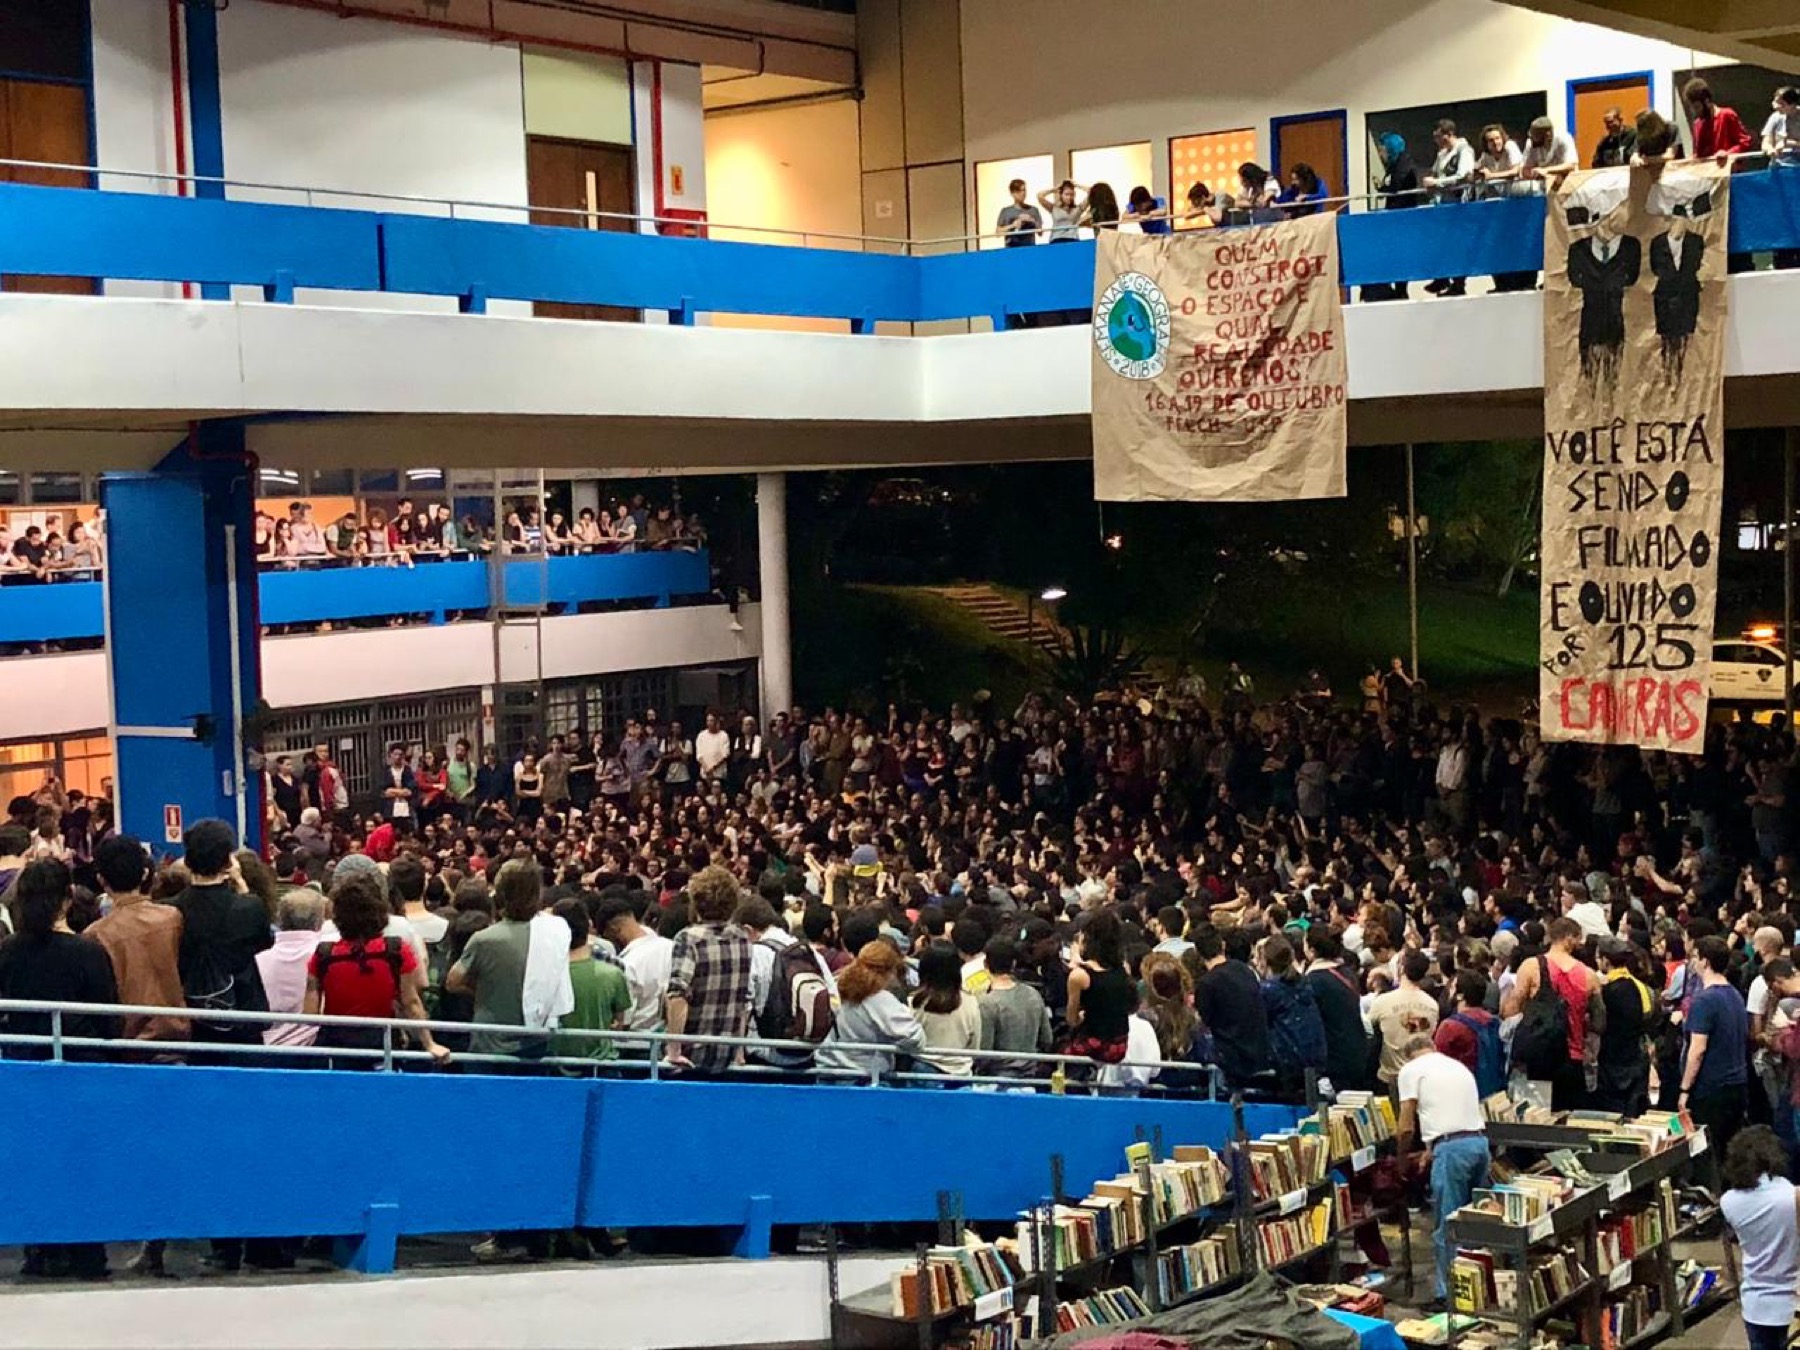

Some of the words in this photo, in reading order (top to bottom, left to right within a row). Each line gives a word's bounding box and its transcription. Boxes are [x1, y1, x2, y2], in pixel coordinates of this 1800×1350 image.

[1206, 248, 1328, 291] CONSTRÓI
[1215, 238, 1278, 266] QUEM
[1181, 297, 1197, 315] O
[1206, 287, 1285, 315] ESPAÇO
[1297, 283, 1309, 303] E
[1145, 393, 1165, 411] 16
[1170, 395, 1180, 414] A
[1186, 394, 1202, 412] 19
[1213, 394, 1236, 413] DE
[1246, 384, 1344, 411] OUTUBRO
[1547, 417, 1627, 464] VOCÊ
[1636, 414, 1713, 463] ESTÁ
[1567, 469, 1690, 512] SENDO
[1578, 524, 1710, 570] FILMADO
[1551, 581, 1572, 631] E
[1578, 576, 1697, 624] OUVIDO
[1543, 633, 1585, 676] POR
[1607, 623, 1699, 671] 125
